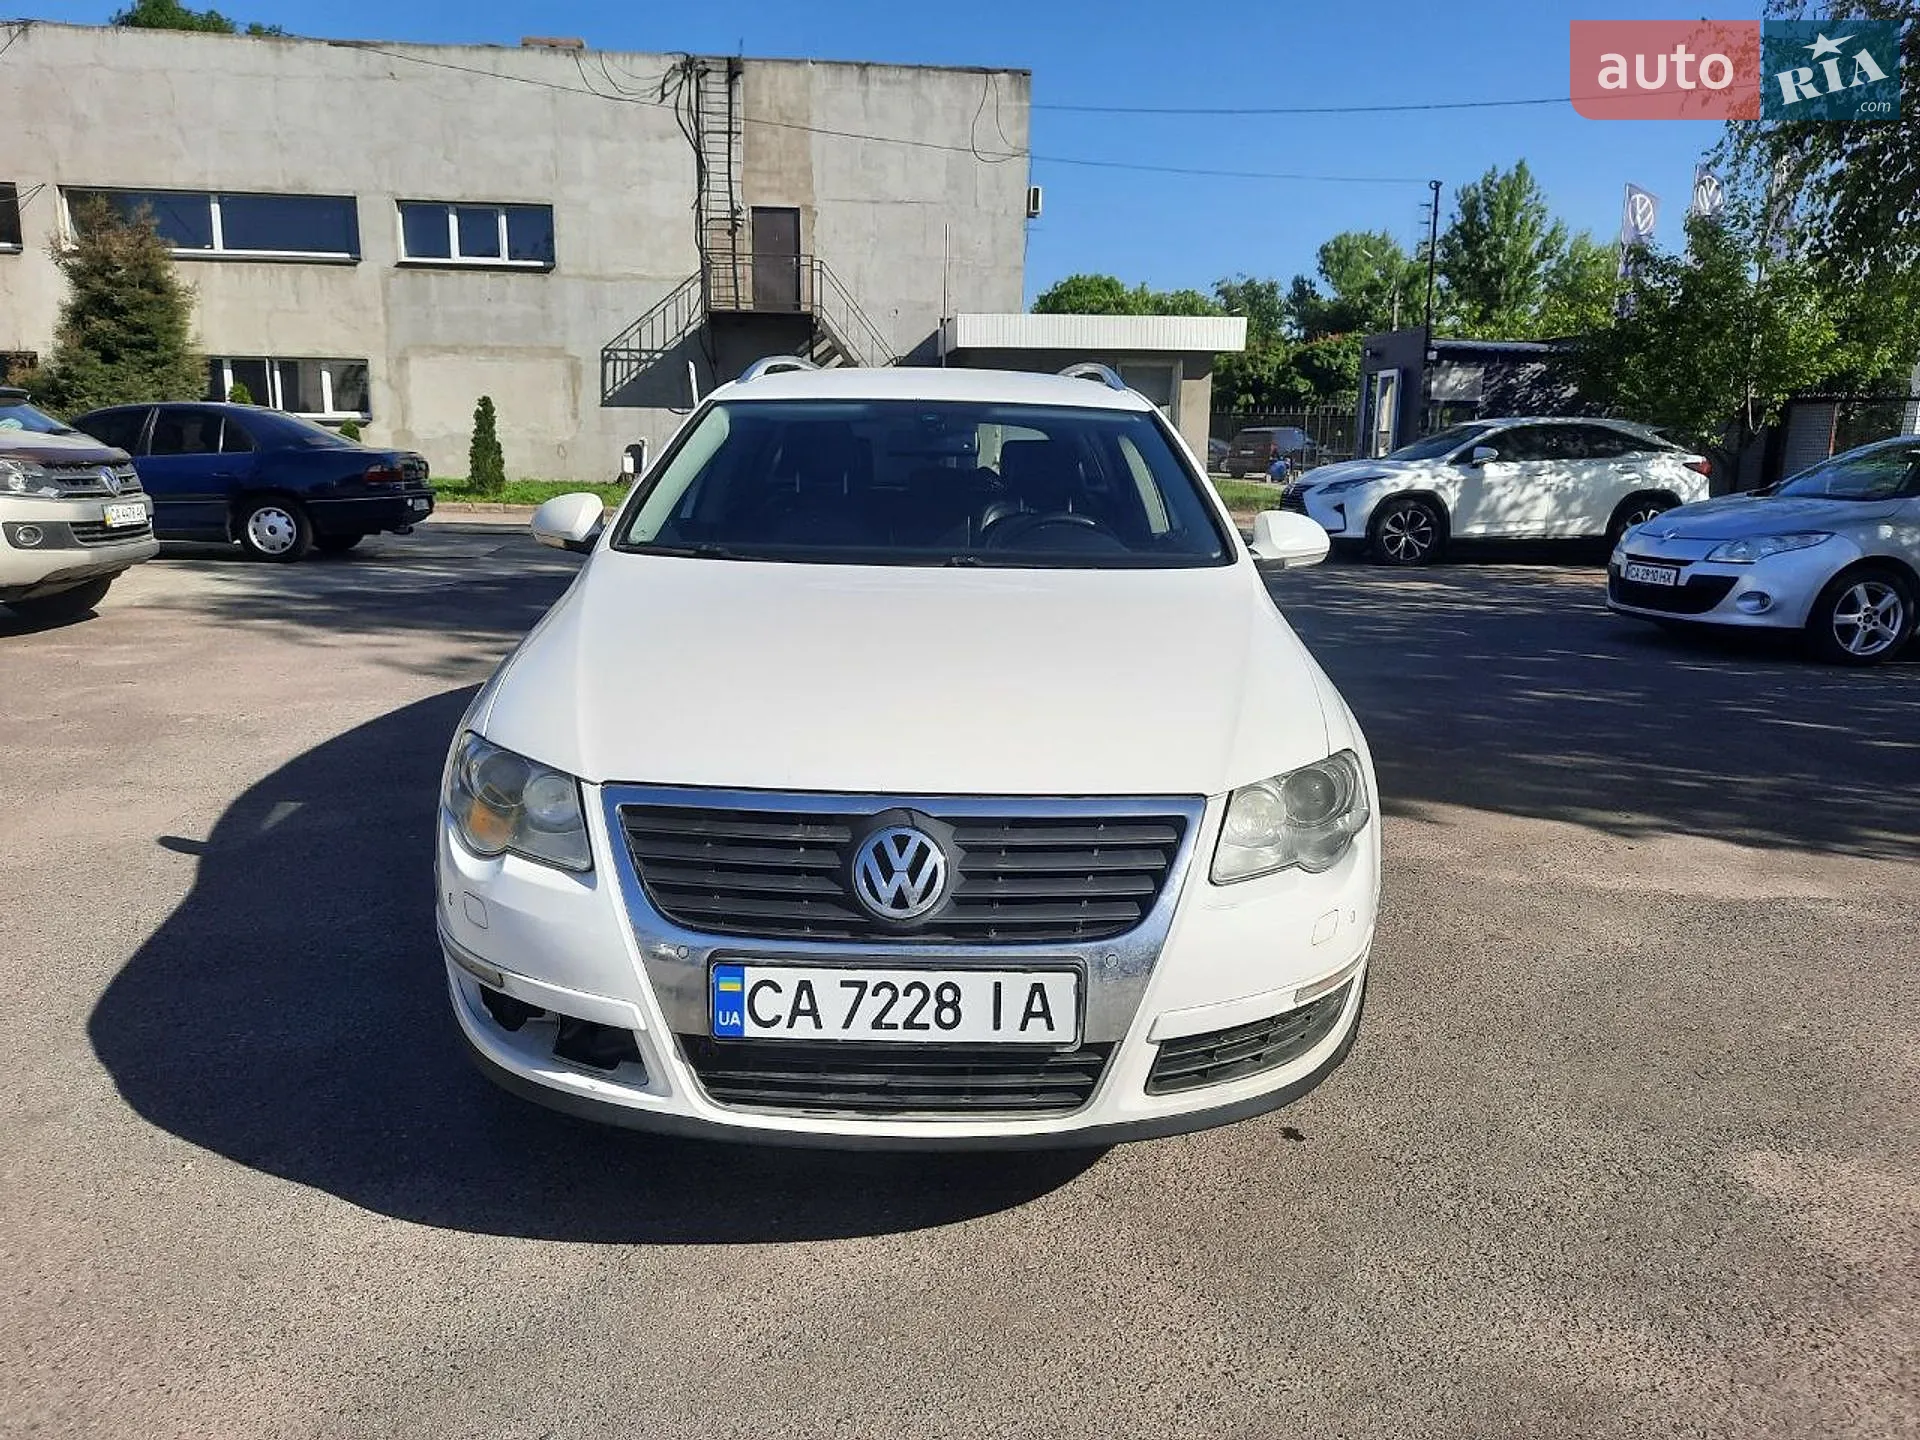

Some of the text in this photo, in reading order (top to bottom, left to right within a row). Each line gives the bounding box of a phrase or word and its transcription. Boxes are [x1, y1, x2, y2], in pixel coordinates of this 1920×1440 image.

[718, 1011, 741, 1027] UA
[747, 980, 824, 1029] CA
[840, 980, 963, 1031] 7228
